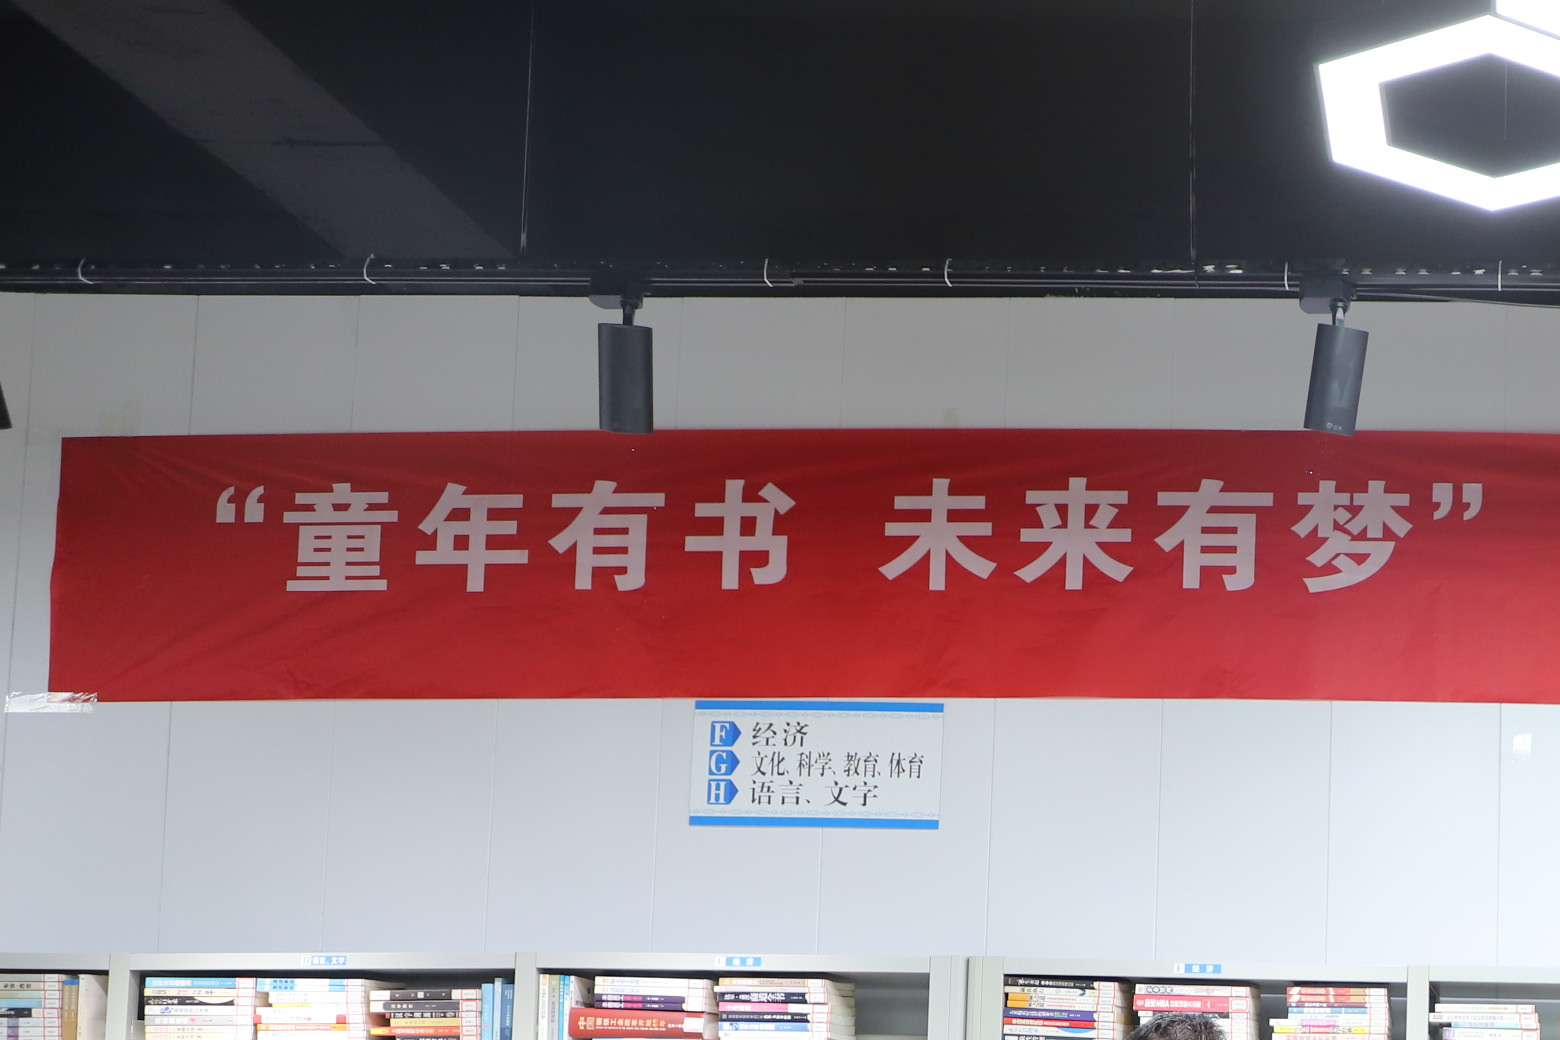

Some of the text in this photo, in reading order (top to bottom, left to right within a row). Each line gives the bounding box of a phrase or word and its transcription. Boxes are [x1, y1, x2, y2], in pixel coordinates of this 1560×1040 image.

[711, 721, 809, 747] F 经济
[710, 751, 727, 775] G
[708, 779, 879, 807] H 语言、文字
